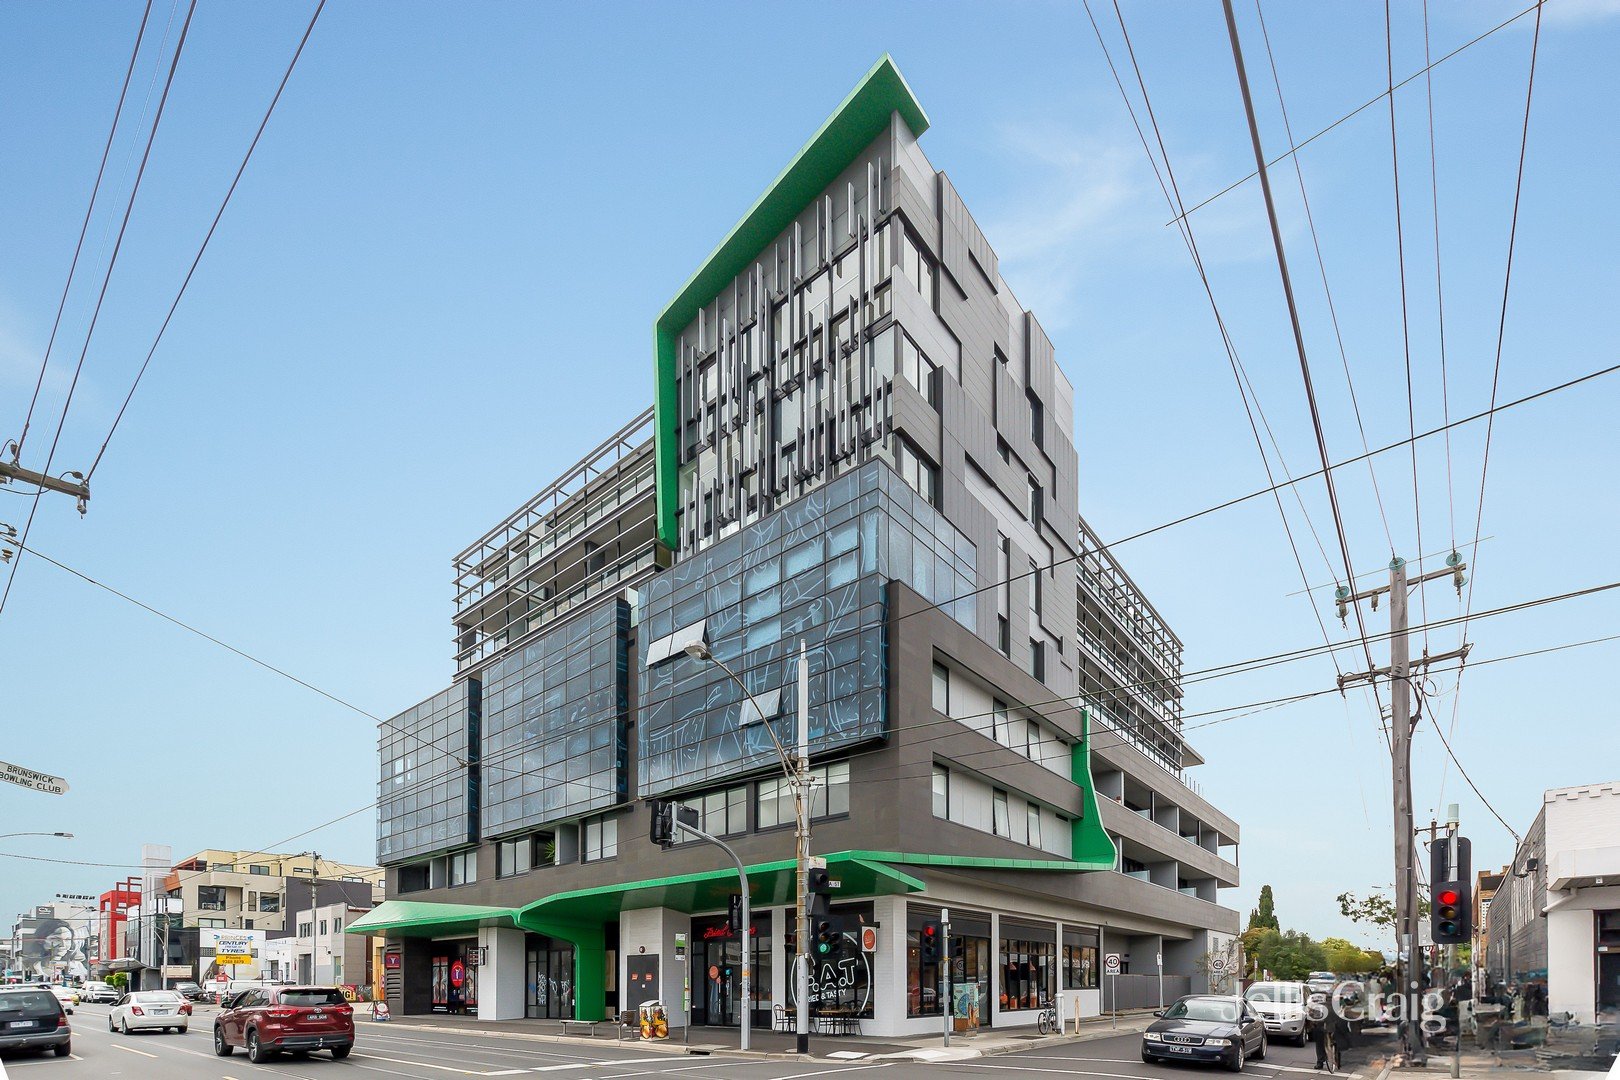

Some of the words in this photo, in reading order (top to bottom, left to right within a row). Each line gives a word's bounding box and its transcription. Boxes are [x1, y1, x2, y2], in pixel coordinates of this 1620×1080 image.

[0, 772, 33, 787] BOWLING
[36, 782, 61, 793] CLUB
[6, 765, 54, 784] BRUNSWICK
[826, 988, 847, 998] TASTY
